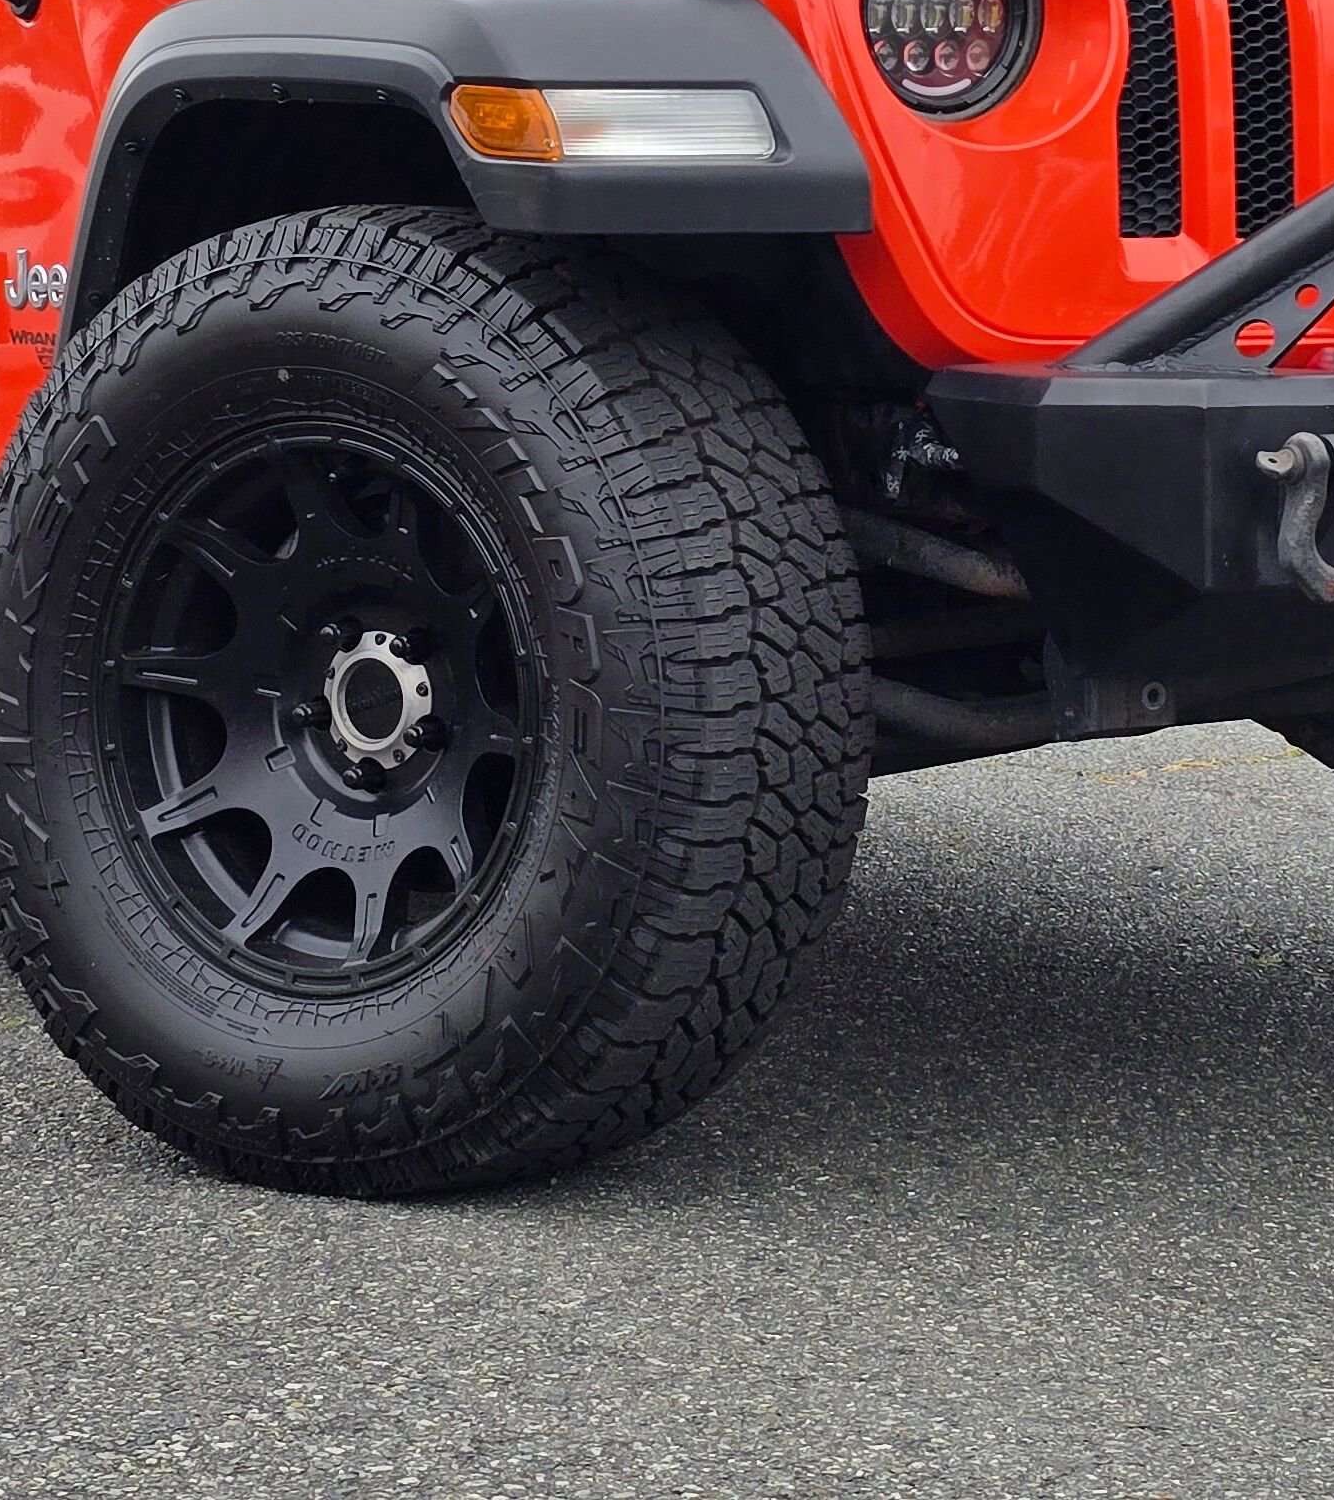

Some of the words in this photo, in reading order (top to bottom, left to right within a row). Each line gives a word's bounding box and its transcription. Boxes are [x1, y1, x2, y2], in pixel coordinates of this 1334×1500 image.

[4, 248, 68, 309] Jee
[9, 329, 56, 346] WRAN
[290, 823, 396, 863] METHOD
